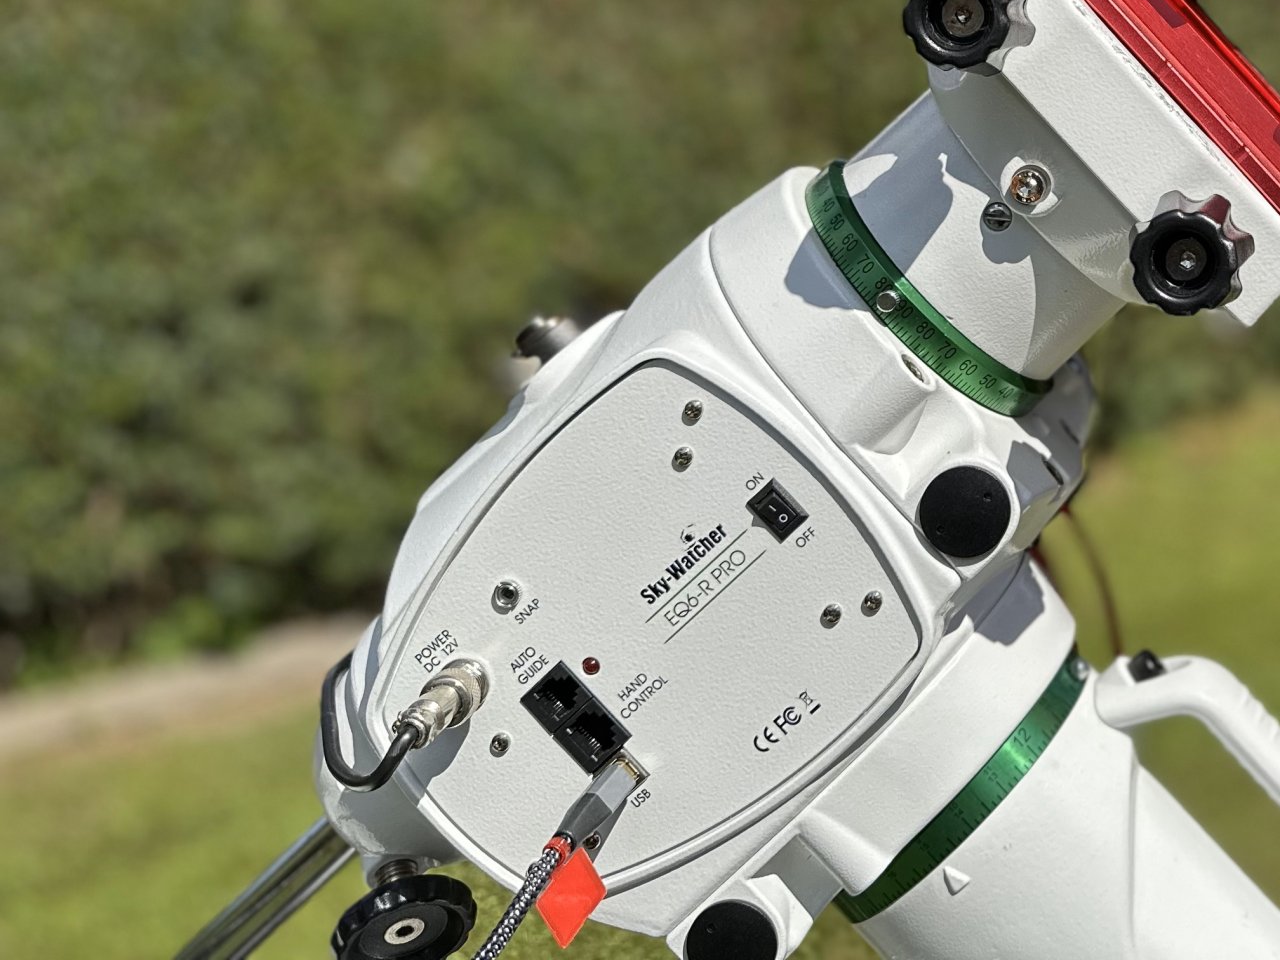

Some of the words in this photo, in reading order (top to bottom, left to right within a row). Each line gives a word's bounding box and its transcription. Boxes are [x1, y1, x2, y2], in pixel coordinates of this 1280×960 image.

[830, 213, 845, 231] 50
[842, 233, 859, 252] 60
[857, 253, 875, 274] 70
[916, 321, 935, 340] 80
[937, 341, 957, 359] 70
[959, 359, 978, 376] 60
[979, 374, 997, 389] 50
[745, 471, 765, 491] ON
[795, 526, 816, 548] OFF
[640, 523, 728, 605] Sky-Watcher
[663, 579, 715, 627] EQ6-R
[710, 549, 746, 585] PRO
[514, 598, 541, 625] SNAP
[414, 629, 453, 664] POWER
[423, 656, 441, 674] DC
[440, 638, 459, 657] 12V
[510, 646, 536, 673] AUTO
[517, 654, 550, 685] GUIDE
[617, 672, 648, 702] HAND
[620, 675, 669, 719] CONTROL
[1013, 727, 1031, 747] 12
[630, 788, 651, 808] USB
